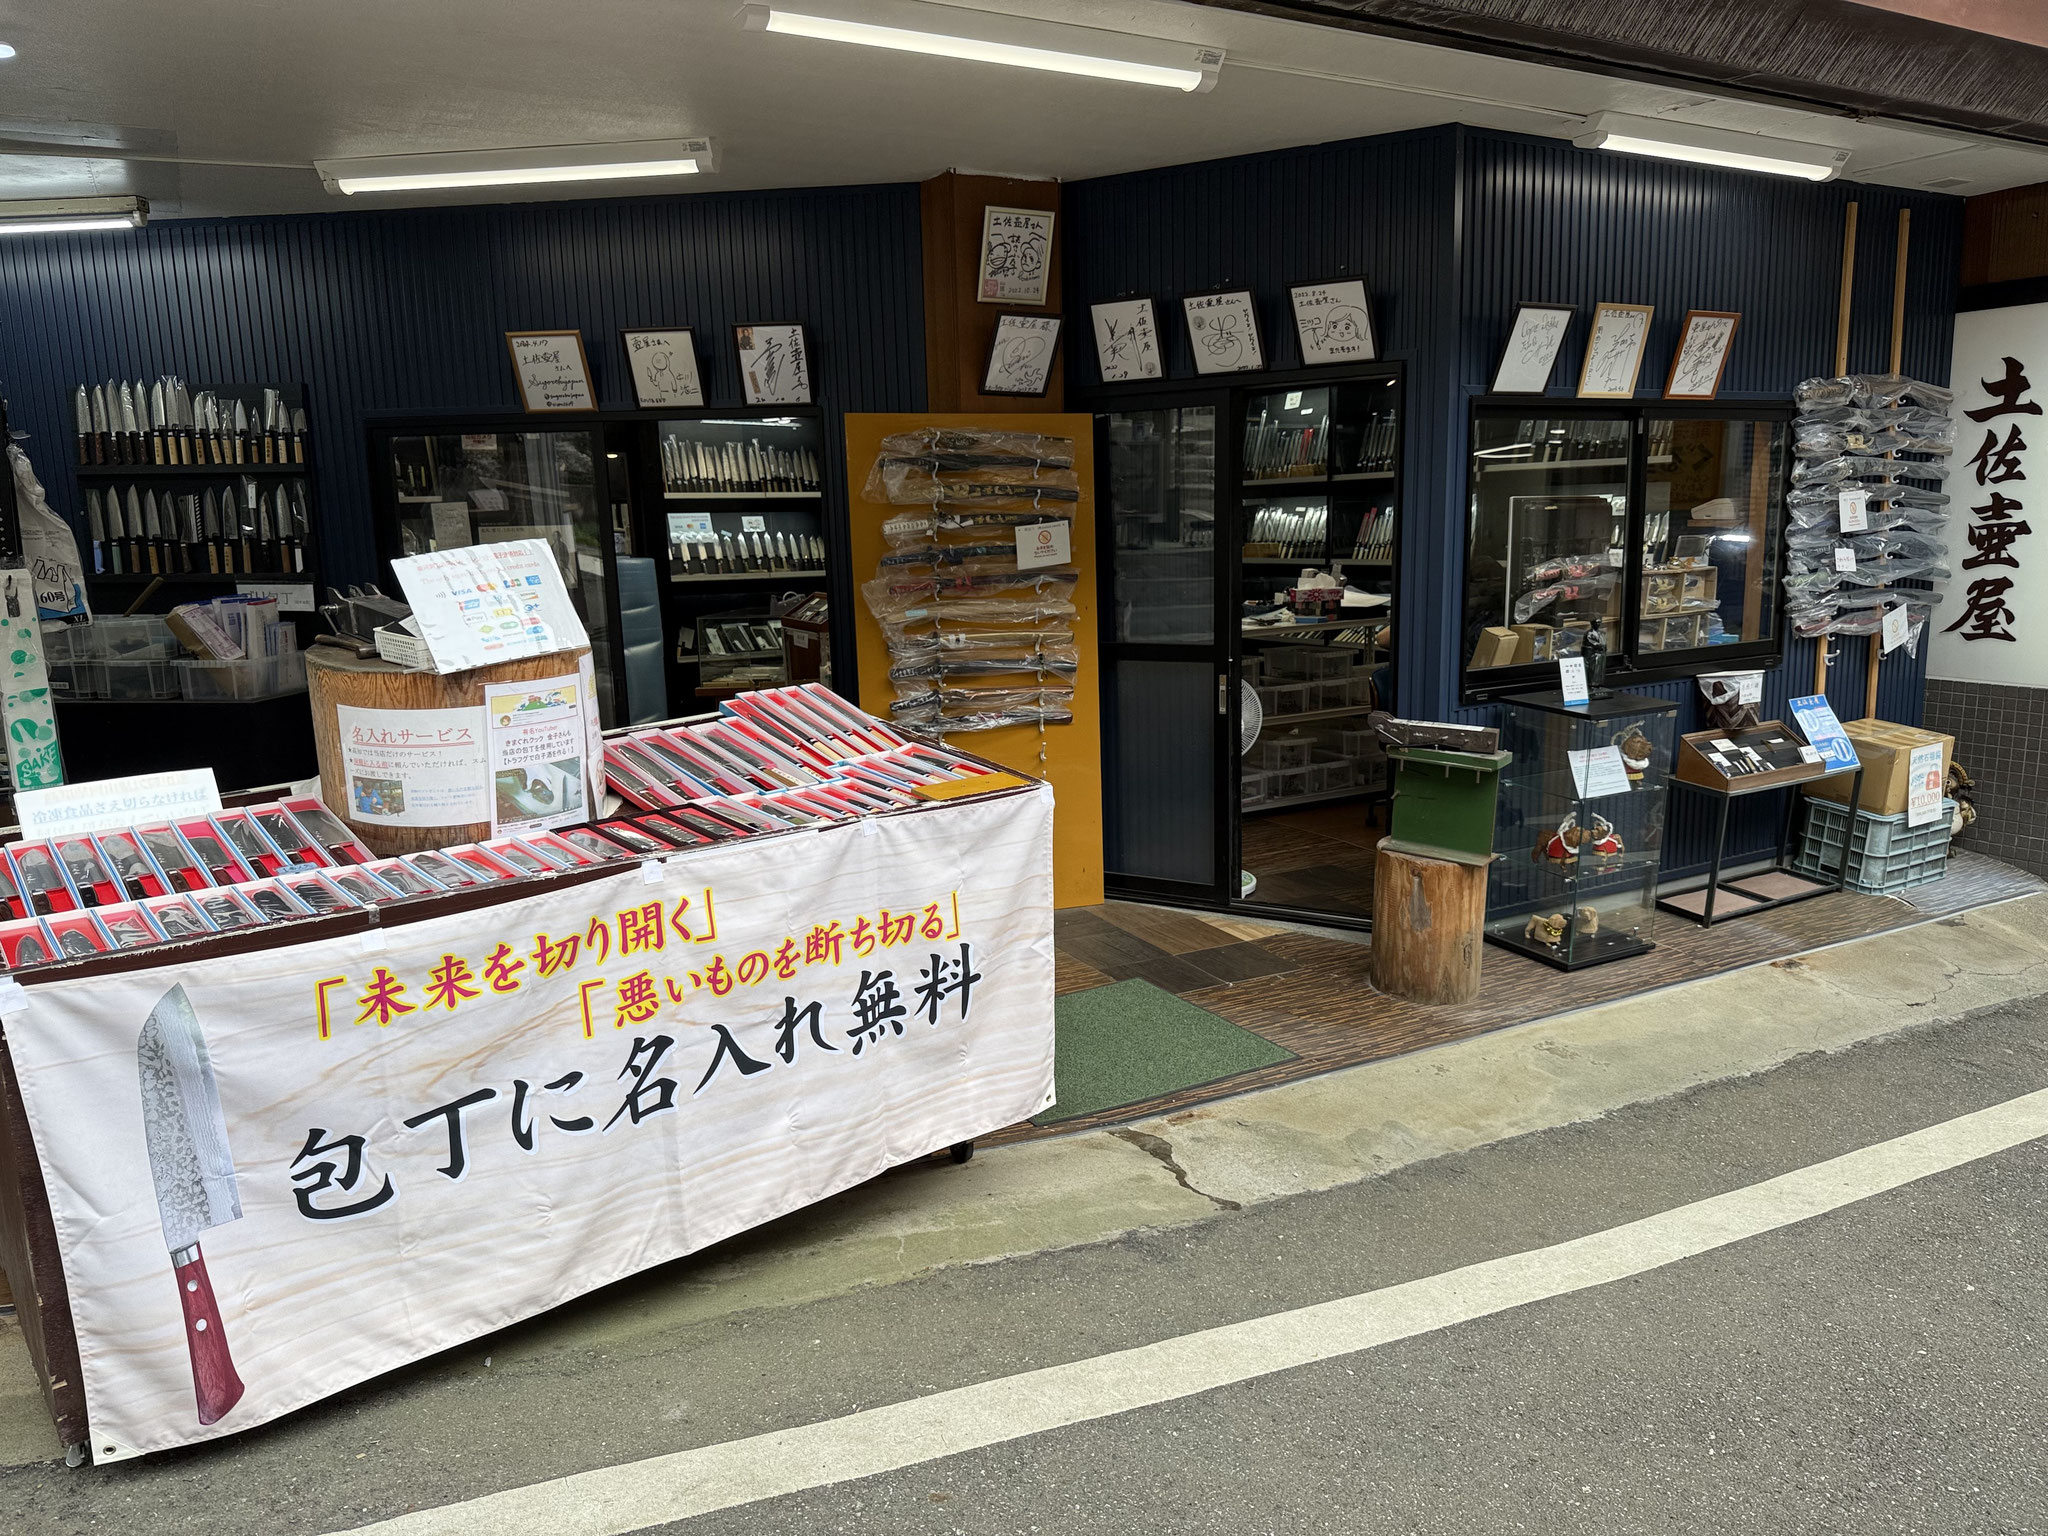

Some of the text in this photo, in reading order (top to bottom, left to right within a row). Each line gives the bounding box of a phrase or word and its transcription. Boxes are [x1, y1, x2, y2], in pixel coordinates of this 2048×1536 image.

[451, 588, 472, 597] VISA
[20, 744, 58, 777] SAKE
[351, 725, 473, 745] 名入れサービス
[315, 888, 716, 1040] 「未来を切り開く」
[578, 891, 960, 1039] 「悪いものを断ち切る」
[291, 942, 982, 1221] 包丁に名入れ無料
